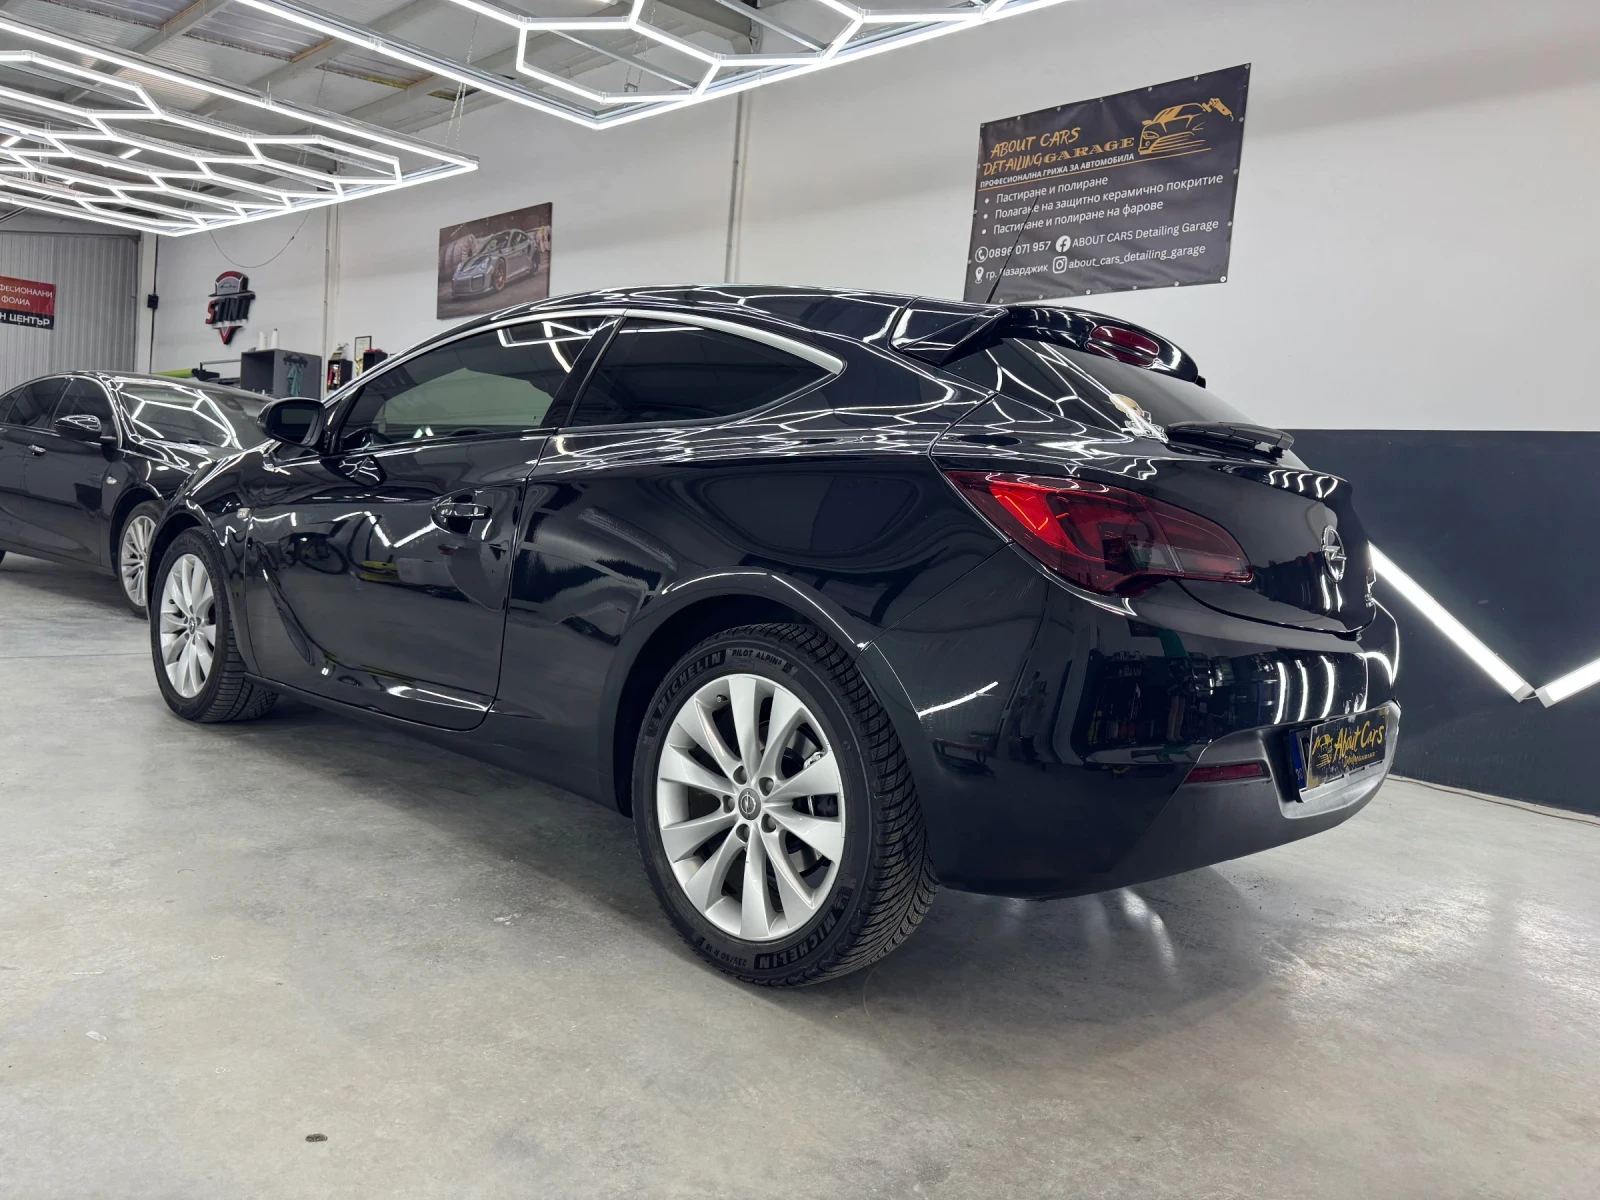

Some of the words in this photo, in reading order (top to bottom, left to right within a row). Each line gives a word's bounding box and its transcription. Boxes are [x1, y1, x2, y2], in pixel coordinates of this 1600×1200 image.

[983, 152, 1042, 176] DETAILING
[1043, 137, 1135, 164] GARAGE
[990, 136, 1036, 158] ABOUT
[1040, 127, 1081, 147] CARS
[980, 167, 1042, 188] ПРОФЕСИОНАЛНА
[1042, 165, 1068, 178] ГРИЖА
[1069, 163, 1080, 173] ЗА
[1080, 153, 1135, 170] АВТОМОБИЛА
[995, 204, 1040, 219] Полагане
[1041, 202, 1053, 212] на
[1055, 194, 1100, 209] защитно
[1102, 183, 1164, 202] керамично
[1166, 174, 1224, 191] покритие
[996, 187, 1047, 204] Пастиране
[1049, 184, 1055, 193] и
[1057, 176, 1108, 193] полиране
[1045, 219, 1052, 227] и
[1054, 210, 1105, 226] полиране
[1107, 207, 1120, 217] на
[1122, 200, 1164, 217] фарове
[1072, 234, 1105, 248] ABOUT
[1107, 230, 1133, 243] CARS
[1135, 224, 1180, 239] Detailing
[1181, 220, 1219, 233] Garage
[988, 246, 1013, 258] 0896
[1015, 243, 1030, 255] 071
[1032, 241, 1052, 252] 957
[1068, 245, 1206, 269] about_cars_detailing_garage
[985, 270, 997, 281] гр.
[1, 295, 31, 306] ФОЛИА
[9, 313, 51, 326] ЦЕНТЪР
[731, 649, 754, 657] PILOT
[657, 651, 722, 714] MICHELIN
[1331, 726, 1361, 763] About
[1360, 720, 1385, 749] Cars
[759, 911, 838, 969] MICHELIN
[720, 952, 747, 967] 235/50
